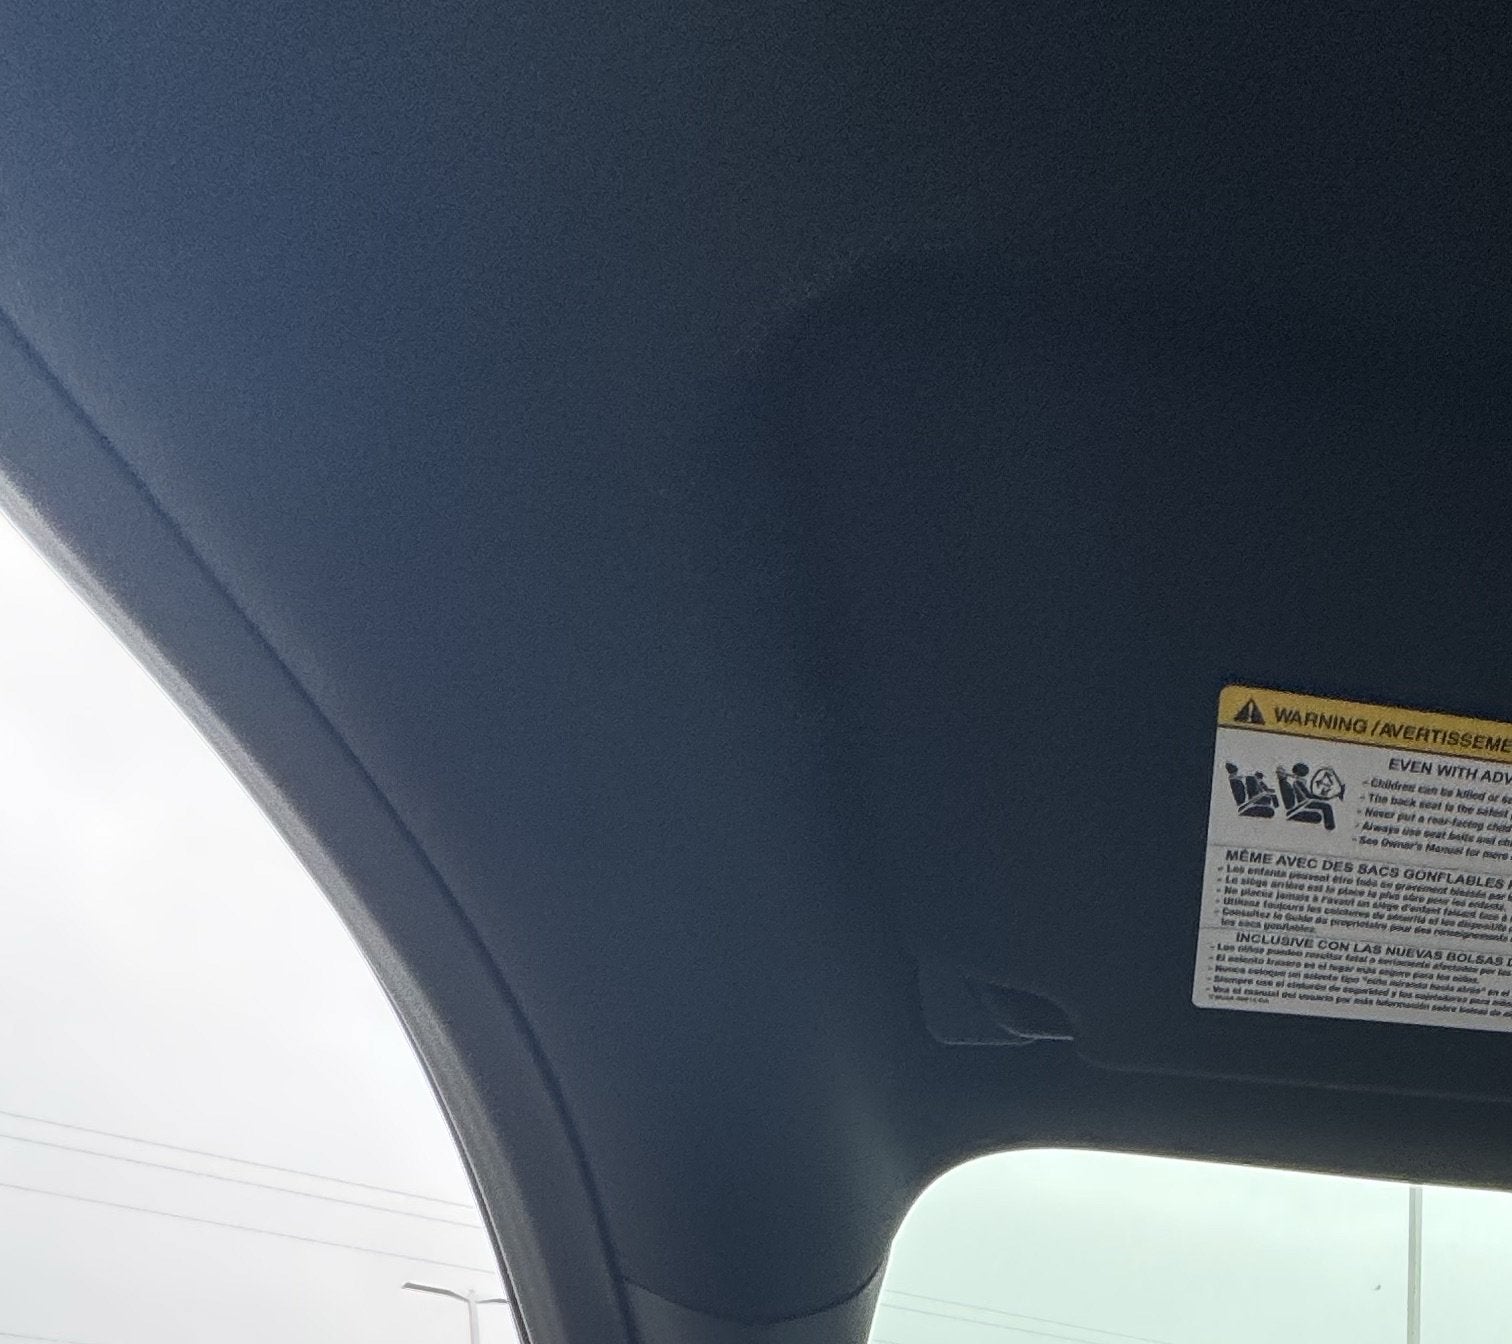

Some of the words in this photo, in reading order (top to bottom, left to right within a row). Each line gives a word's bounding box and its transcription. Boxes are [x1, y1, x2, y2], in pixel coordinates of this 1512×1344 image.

[1273, 705, 1368, 735] WARNING
[1388, 756, 1433, 774] EVEN
[1435, 763, 1478, 780] WITH
[1225, 846, 1275, 864] MÊME
[1275, 852, 1318, 869] AVEC
[1321, 857, 1354, 873] DES
[1357, 861, 1400, 878] SACS
[1402, 866, 1505, 890] GONFLABLES
[1236, 931, 1314, 949] INCLUSIVE
[1317, 939, 1350, 952] CON
[1353, 942, 1382, 955] LAS
[1385, 945, 1443, 961] NUEVAS
[1445, 951, 1504, 966] BOLSAS
